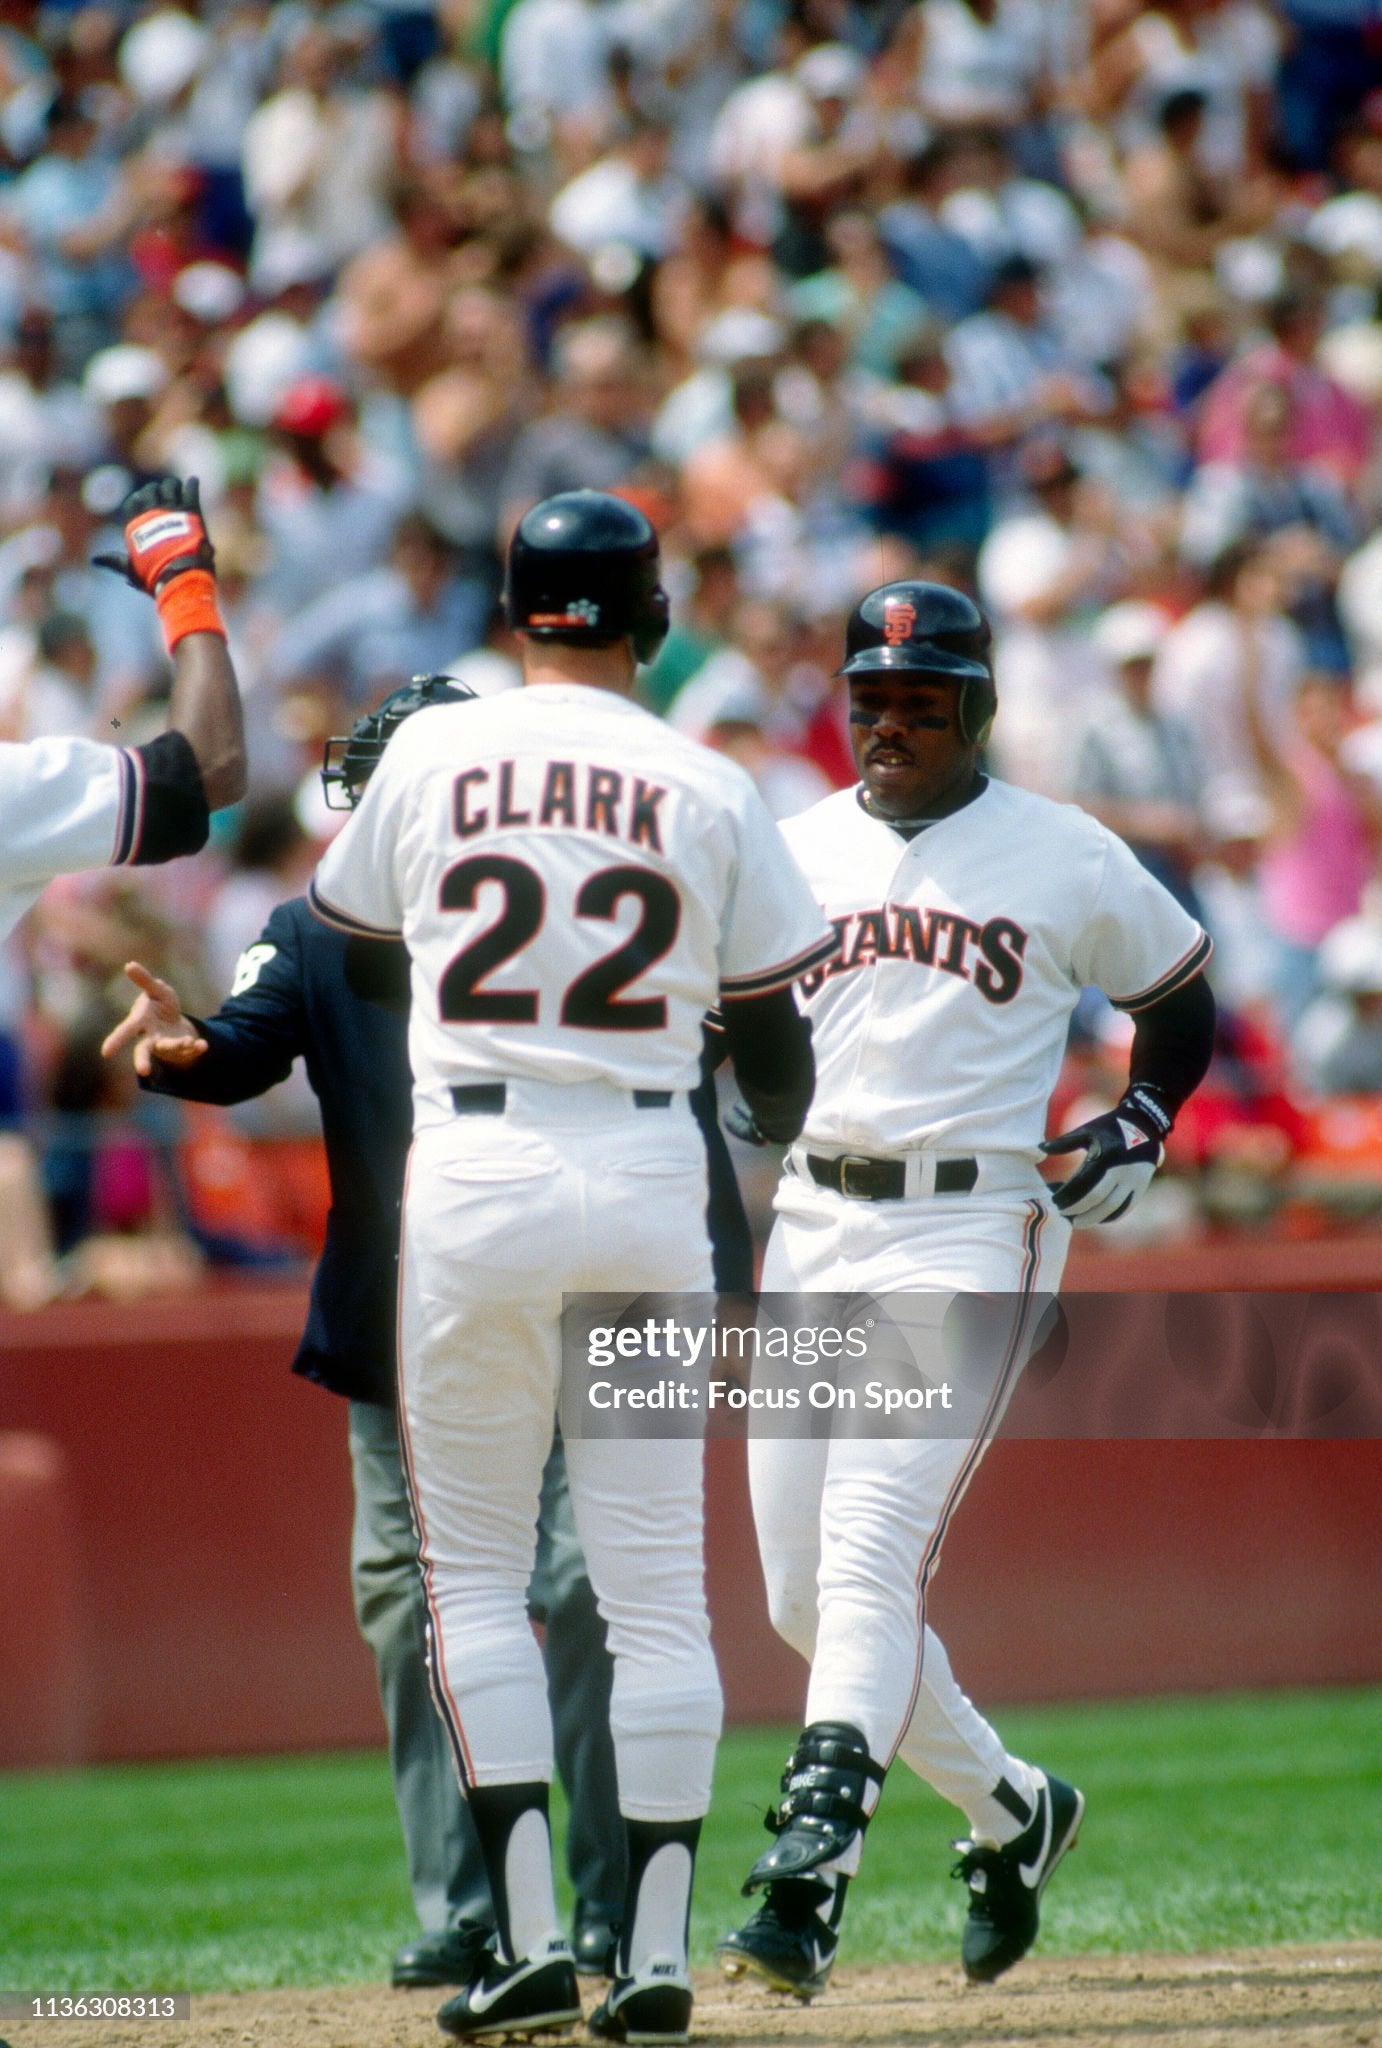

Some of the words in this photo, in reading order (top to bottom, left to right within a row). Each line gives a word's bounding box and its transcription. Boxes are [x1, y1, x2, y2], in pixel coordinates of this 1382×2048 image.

[883, 603, 917, 647] SF
[453, 759, 669, 857] CLARK
[438, 852, 683, 1034] 22
